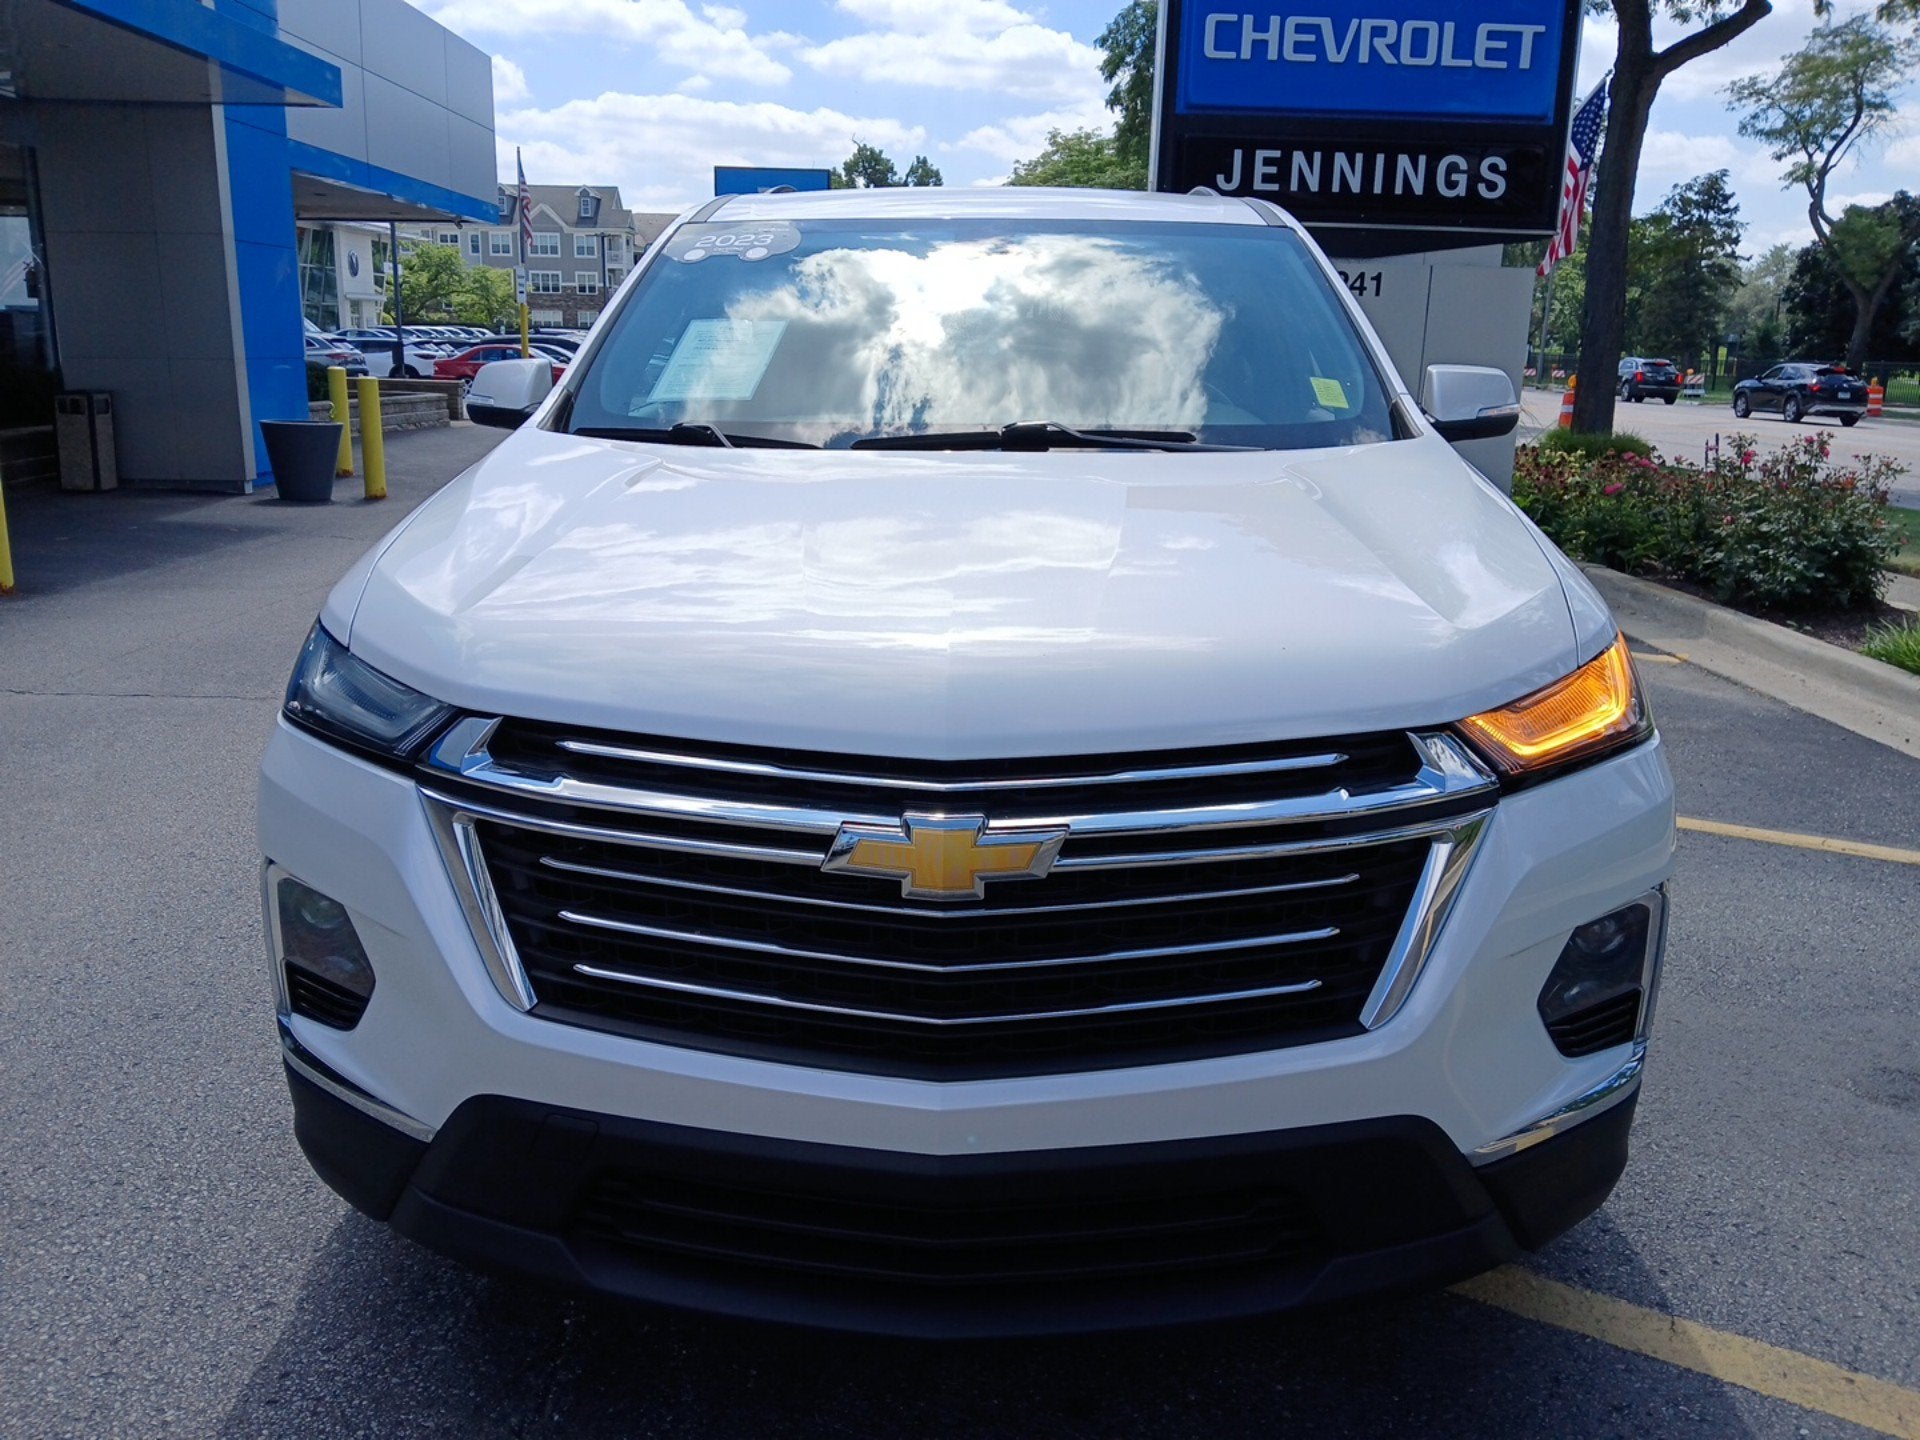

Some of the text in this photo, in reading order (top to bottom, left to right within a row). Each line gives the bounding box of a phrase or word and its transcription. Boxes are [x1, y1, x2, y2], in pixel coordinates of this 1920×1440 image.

[1204, 13, 1546, 69] CHEVROLET
[1216, 149, 1508, 199] JENNINGS
[695, 235, 774, 247] 2023
